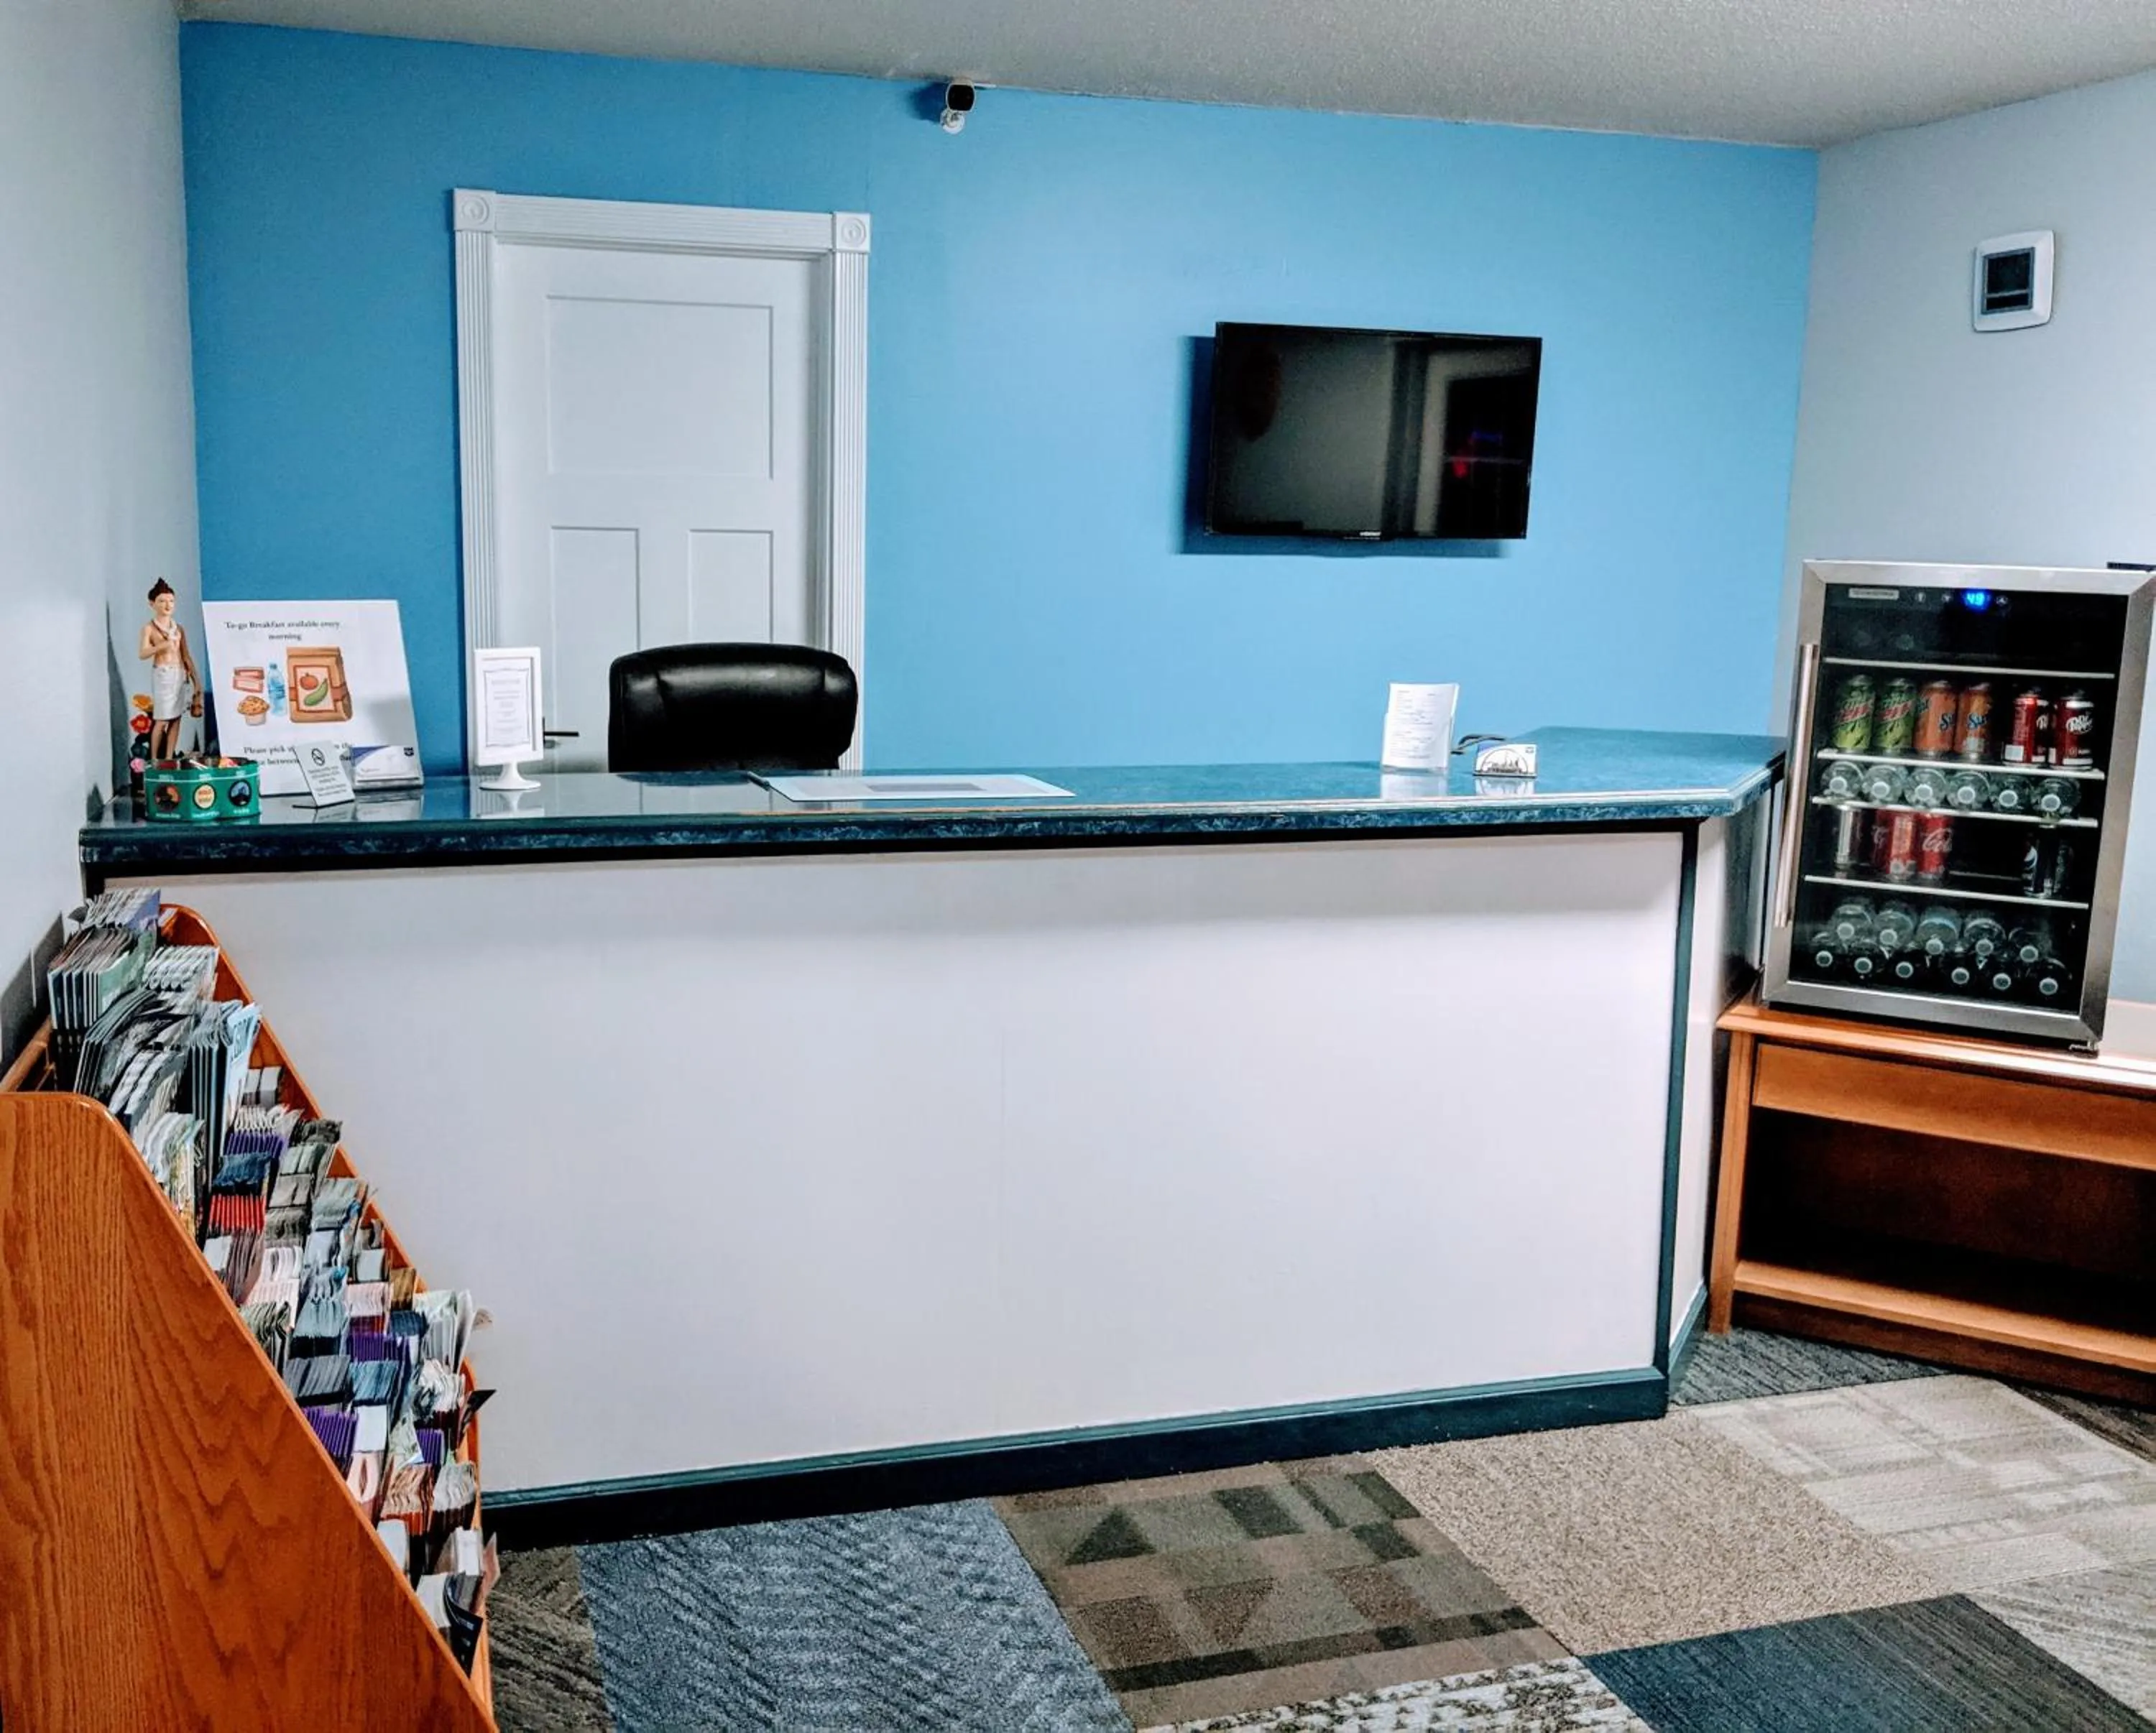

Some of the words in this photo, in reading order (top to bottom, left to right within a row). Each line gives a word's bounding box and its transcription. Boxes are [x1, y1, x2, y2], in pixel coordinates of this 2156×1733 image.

[249, 620, 285, 629] Breakfast
[268, 632, 302, 642] morning
[270, 745, 285, 755] pick
